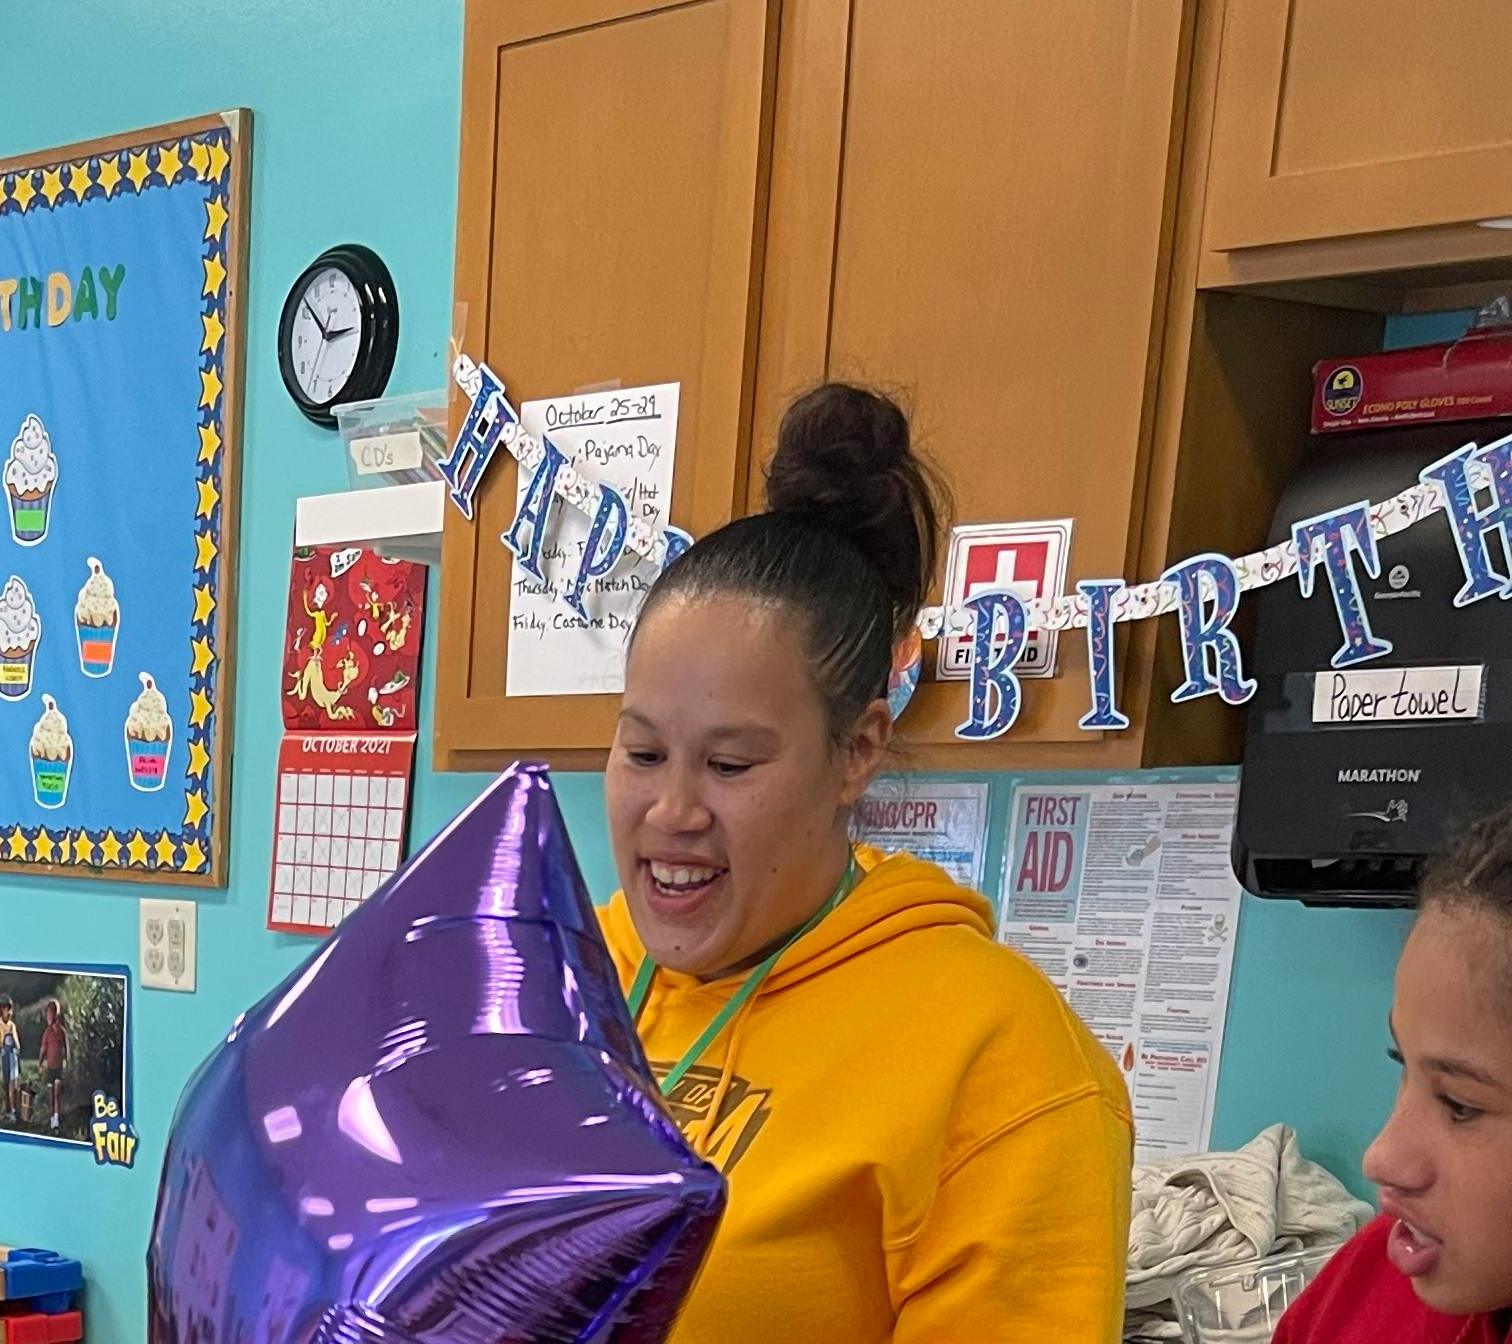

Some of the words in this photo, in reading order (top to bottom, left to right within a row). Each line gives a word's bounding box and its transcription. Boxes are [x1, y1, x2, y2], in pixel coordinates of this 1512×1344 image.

[545, 404, 605, 427] October
[610, 394, 658, 418] 25-29
[1363, 402, 1395, 415] ECONO
[1396, 399, 1417, 412] POLY
[1419, 396, 1455, 409] GLOVES
[360, 443, 394, 467] CD's
[585, 438, 635, 465] Pajama
[637, 434, 663, 471] Day
[608, 612, 634, 646] Day
[1330, 673, 1387, 722] Paper
[1391, 668, 1468, 717] towel
[301, 737, 358, 753] OCTOBER
[360, 739, 392, 754] 2021
[1338, 768, 1421, 783] MARATHON
[1025, 796, 1081, 826] FIRST
[1016, 831, 1074, 893] AID
[94, 1093, 119, 1119] Be
[92, 1122, 136, 1165] Fair
